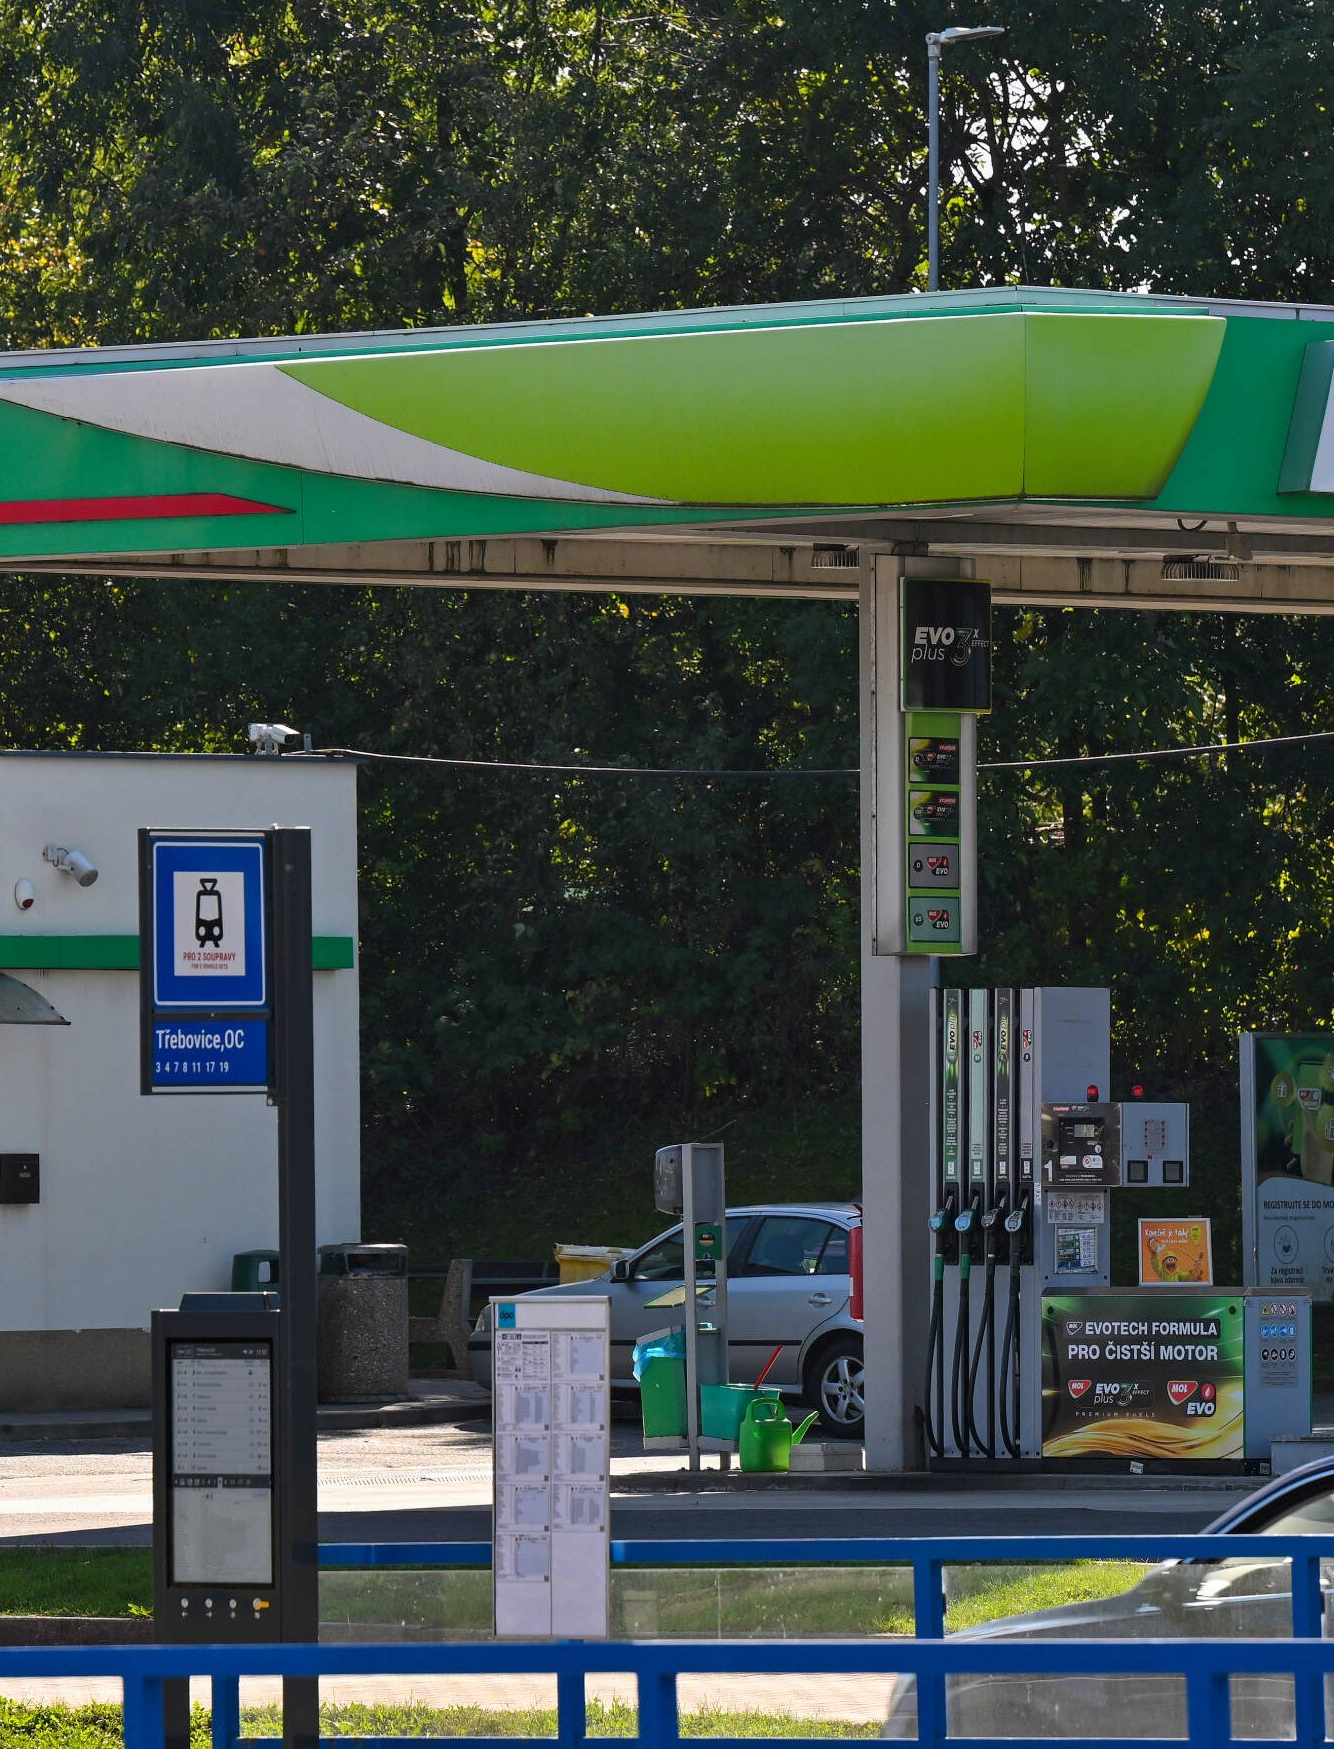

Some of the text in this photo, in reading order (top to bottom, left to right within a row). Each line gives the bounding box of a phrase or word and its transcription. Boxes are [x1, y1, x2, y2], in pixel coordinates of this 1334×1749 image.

[914, 626, 955, 646] EVO
[971, 639, 990, 648] EFFECT
[911, 643, 946, 664] plus
[183, 952, 236, 962] PRO 2 SOUPRAVY
[155, 1029, 245, 1052] Třebovice,OC
[155, 1061, 229, 1073] 3 4 7 8 11 17 19
[1043, 1159, 1054, 1182] 1
[1264, 1200, 1302, 1209] REGISTRUJTE
[1303, 1201, 1310, 1209] SE
[1312, 1201, 1322, 1209] DO
[1085, 1322, 1148, 1335] EVOTECH
[1152, 1322, 1218, 1335] FORMULA
[1068, 1341, 1219, 1361] PRO ČISTŠÍ MOTOR
[1095, 1383, 1120, 1394] EVO
[1171, 1383, 1188, 1393] MOL
[1093, 1393, 1114, 1405] plus
[1186, 1402, 1215, 1415] EVO
